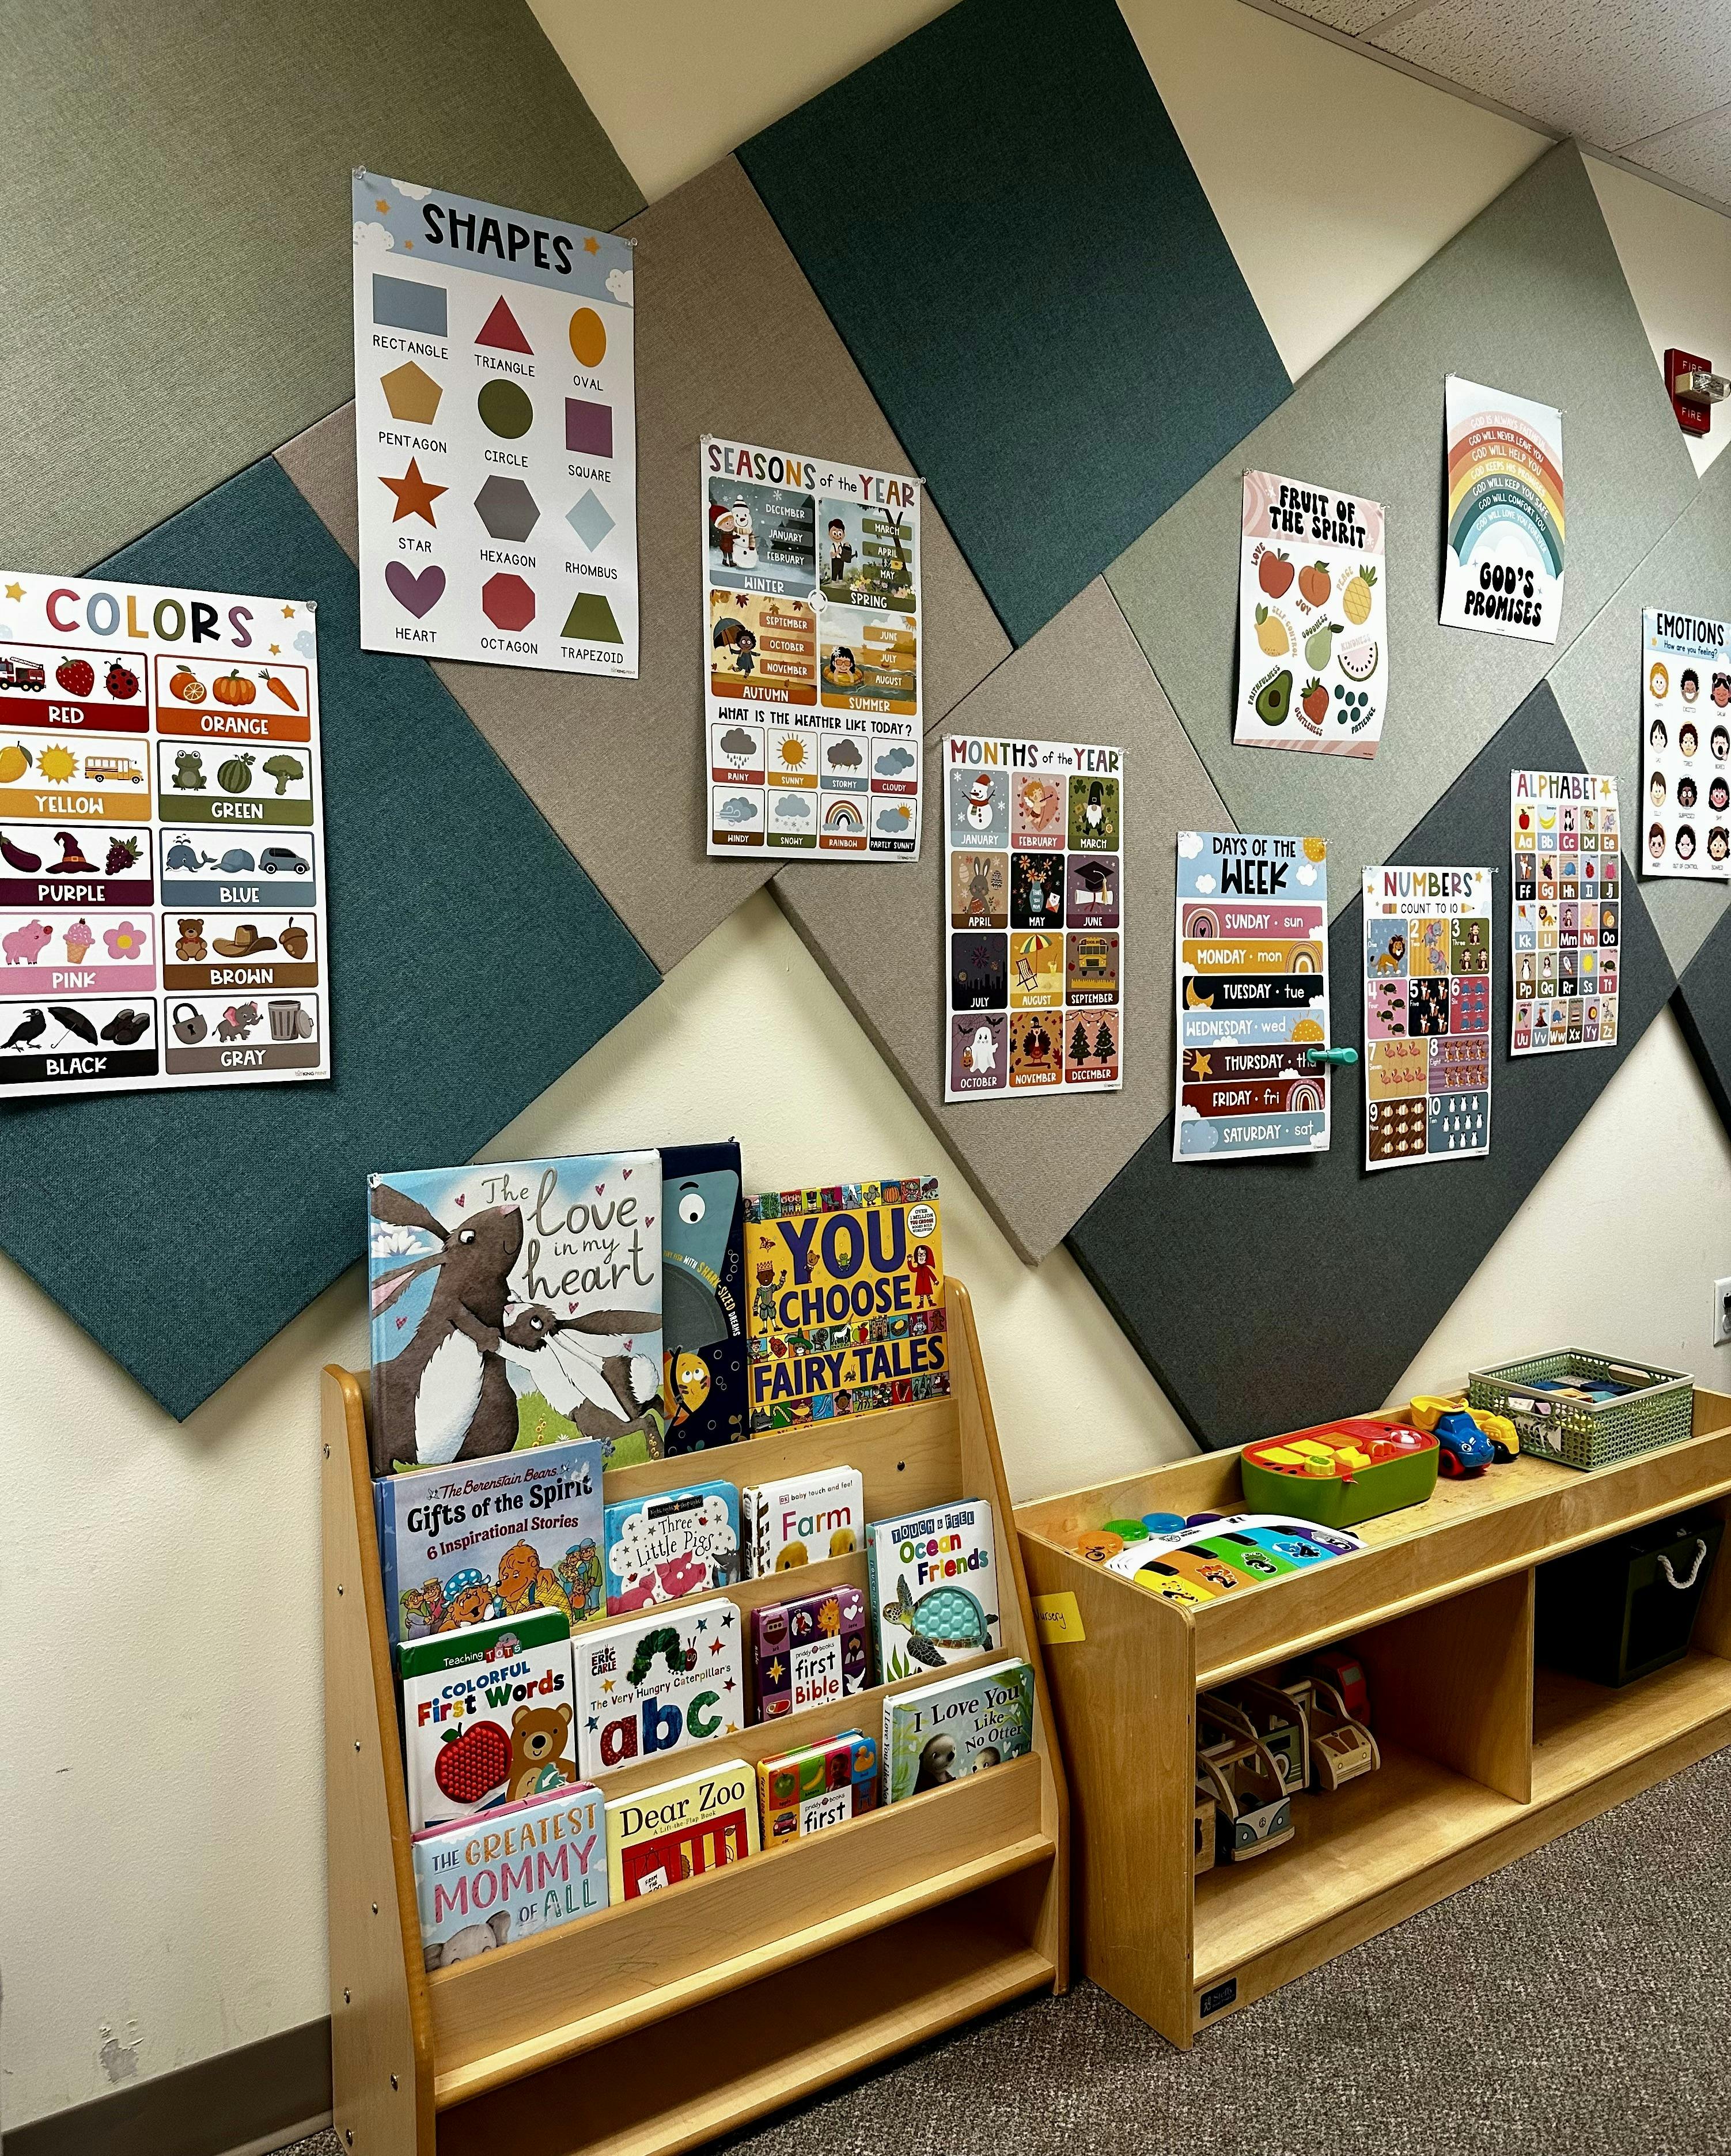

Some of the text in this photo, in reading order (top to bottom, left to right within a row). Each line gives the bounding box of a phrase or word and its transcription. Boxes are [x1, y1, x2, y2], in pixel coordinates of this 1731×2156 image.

[422, 203, 574, 275] SHAPES
[373, 335, 449, 360] RECTANGLE
[1681, 407, 1702, 422] FIRE
[378, 432, 447, 453] PENTAGON
[708, 444, 915, 508] SEASONS of the YEAR
[1279, 485, 1355, 524] FRUIT OF
[1478, 493, 1546, 532] GOD WILL COMFORT YOU
[1269, 506, 1366, 549] THE SPIRIT
[1251, 542, 1266, 566] LOVE
[565, 562, 618, 580] RHOMBUS
[1479, 562, 1534, 599] GOD'S
[744, 576, 785, 593] WINTER
[46, 588, 254, 648] COLORS
[1296, 599, 1311, 616] JOY
[1464, 590, 1542, 627] PROMISES
[1302, 614, 1328, 638] GOODNESS
[1657, 612, 1724, 646] EMOTIONS
[560, 646, 623, 664] TRAPEZOID
[1664, 640, 1675, 650] How
[1687, 646, 1696, 655] you
[1698, 645, 1718, 659] feeling?
[1248, 664, 1281, 705] FAITHFULNESS
[849, 698, 891, 712] SUMMER
[200, 714, 270, 735] ORANGE
[718, 707, 912, 736] WHAT IS THE WEATHER LIKE TODAY?
[1294, 707, 1323, 736] GENTLENESS
[950, 739, 1119, 773] MONTHS of the YEAR
[728, 773, 749, 782] RAINY
[781, 776, 804, 785] SUNNY
[882, 783, 906, 792] CLOUDY
[1517, 774, 1597, 800] ALPHABET
[35, 795, 104, 815] YELLOW
[211, 801, 264, 819] GREEN
[870, 840, 914, 850] PARTLY SUNNY
[1213, 837, 1296, 858] DAYS OF THE
[1518, 834, 1533, 849] Aa
[1541, 835, 1554, 849] Bb
[1563, 835, 1575, 849] Cc
[1221, 858, 1289, 894] WEEK
[1384, 872, 1473, 897] NUMBERS
[219, 886, 260, 903] BLUE
[1225, 913, 1304, 929] SUNDAY sun
[1401, 903, 1458, 913] COUNT TO 10
[968, 917, 992, 927] APRIL
[1410, 919, 1420, 938] 2
[1452, 919, 1460, 937] 3
[1071, 993, 1113, 1004] SEPTEMBER
[1186, 1016, 1286, 1037] WEDNESDAY wed
[46, 1056, 108, 1076] BLACK
[1071, 1069, 1112, 1081] DECEMBER
[1430, 1058, 1441, 1066] Eight
[1223, 1120, 1314, 1143] SATURDAY sat
[482, 1173, 529, 1204] The
[527, 1167, 638, 1236] love
[555, 1236, 620, 1265] in my
[776, 1207, 907, 1286] YOU
[522, 1228, 655, 1300] heart
[683, 1255, 698, 1269] WITH
[728, 1311, 741, 1337] DREAMS
[778, 1274, 912, 1329] CHOOSE
[753, 1334, 945, 1404] FAIRY TALES
[440, 1467, 556, 1500] The Berenstain Bears
[791, 1480, 853, 1501] baby touch and feel
[407, 1474, 593, 1538] Gifts of the Spirit
[426, 1513, 579, 1561] 6 Inspirational Stories
[658, 1516, 693, 1535] Three
[782, 1507, 851, 1542] Farm
[892, 1511, 975, 1544] TOUCH & FEEL
[636, 1530, 715, 1568] Little Pigs
[899, 1533, 962, 1564] Ocean
[918, 1548, 989, 1586] Friends
[443, 1645, 522, 1667] Teaching TOTS
[591, 1651, 616, 1666] ERIC
[591, 1660, 617, 1677] CARLE
[795, 1651, 836, 1680] first
[441, 1661, 531, 1700] COLORFUL
[590, 1665, 731, 1712] The Very Hungry Caterpillar's
[796, 1675, 839, 1705] Bible
[418, 1669, 565, 1727] First Words
[914, 1685, 1021, 1733] I Love You
[600, 1690, 723, 1767] abc
[974, 1713, 1005, 1733] Like
[964, 1724, 1024, 1754] No Otter
[619, 1781, 745, 1838] Dear Zoo
[700, 1809, 716, 1820] Book
[432, 1802, 597, 1871] THE GREATEST
[434, 1833, 598, 1924] MOMMY
[519, 1878, 597, 1922] OF ALL
